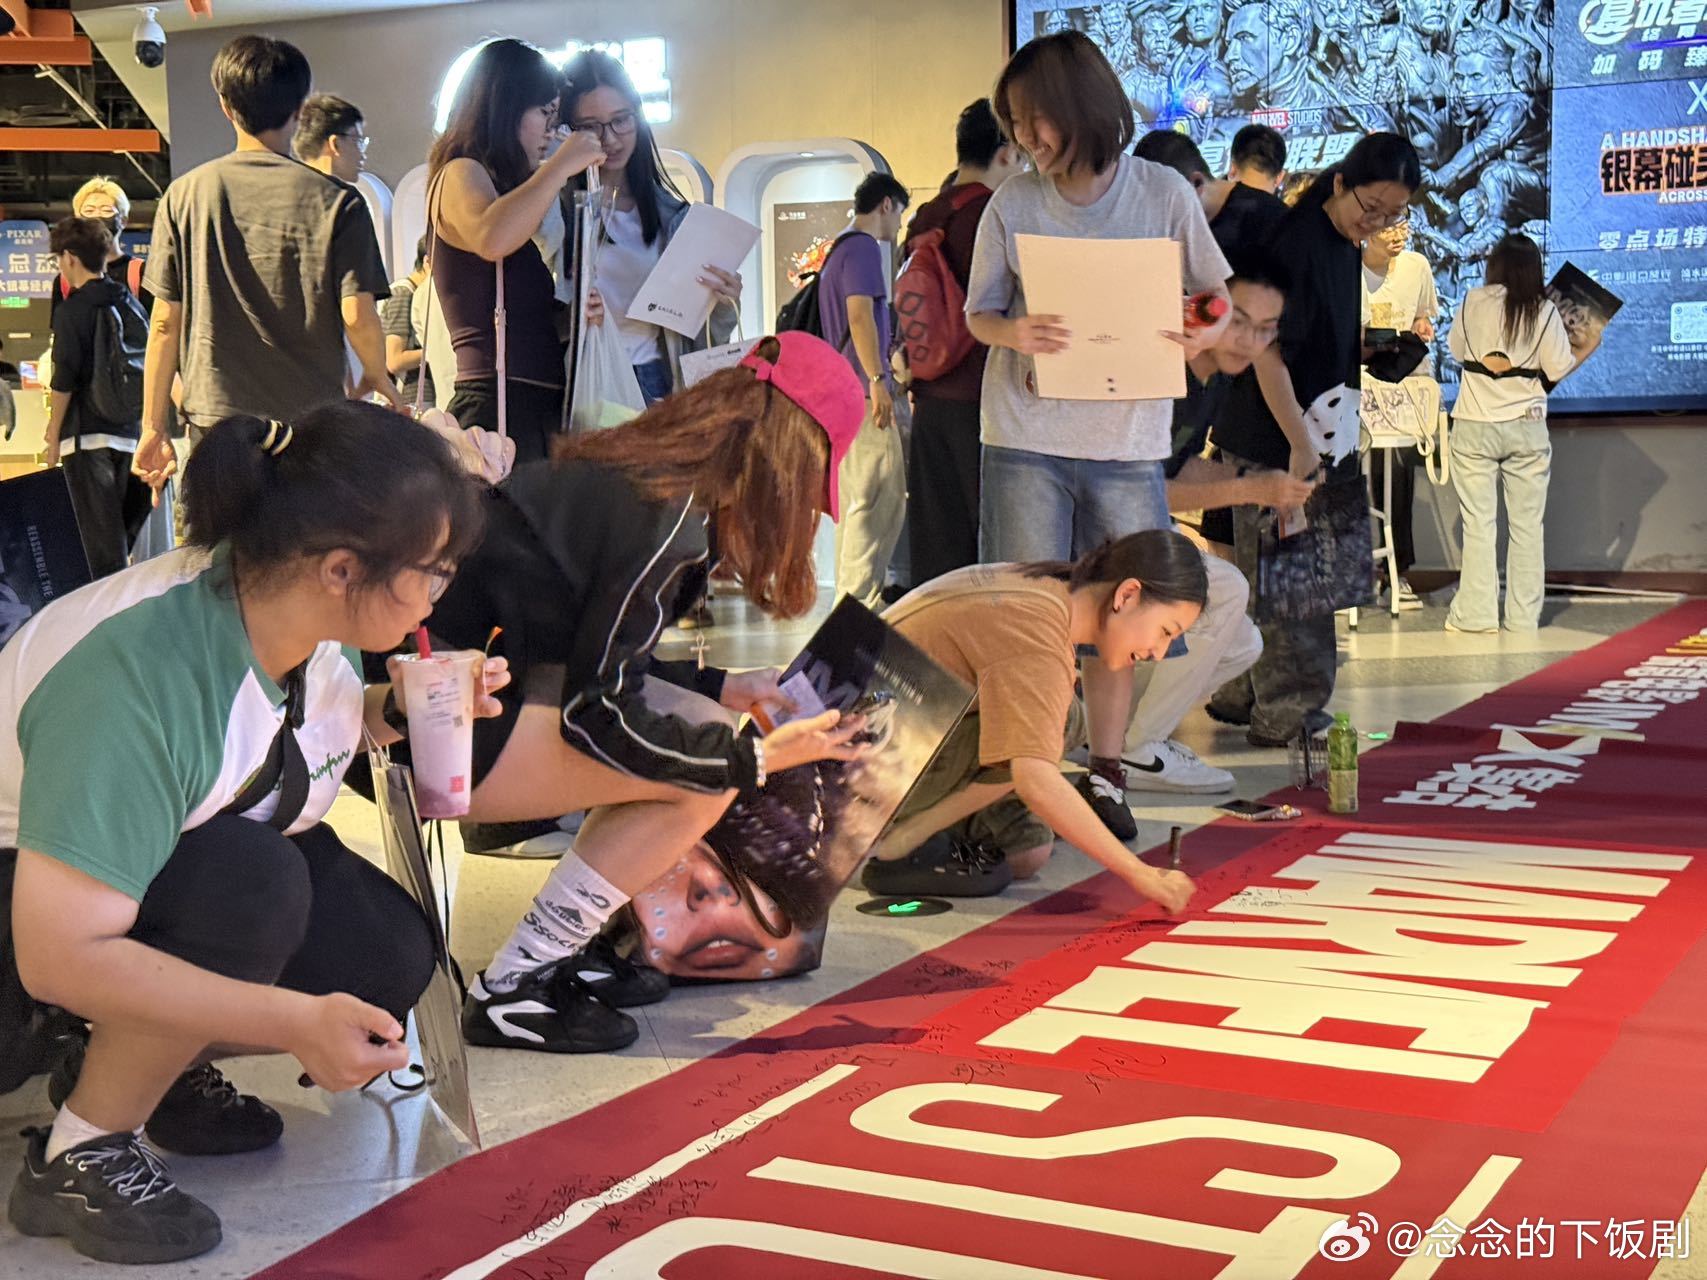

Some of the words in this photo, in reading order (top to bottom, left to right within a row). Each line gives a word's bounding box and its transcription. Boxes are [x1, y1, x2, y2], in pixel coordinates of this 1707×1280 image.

[1287, 109, 1322, 125] STUDIOS
[1601, 132, 1615, 150] A
[1621, 126, 1707, 149] HANDSH
[6, 230, 42, 239] PIXAR
[976, 832, 1693, 1084] MARVEL
